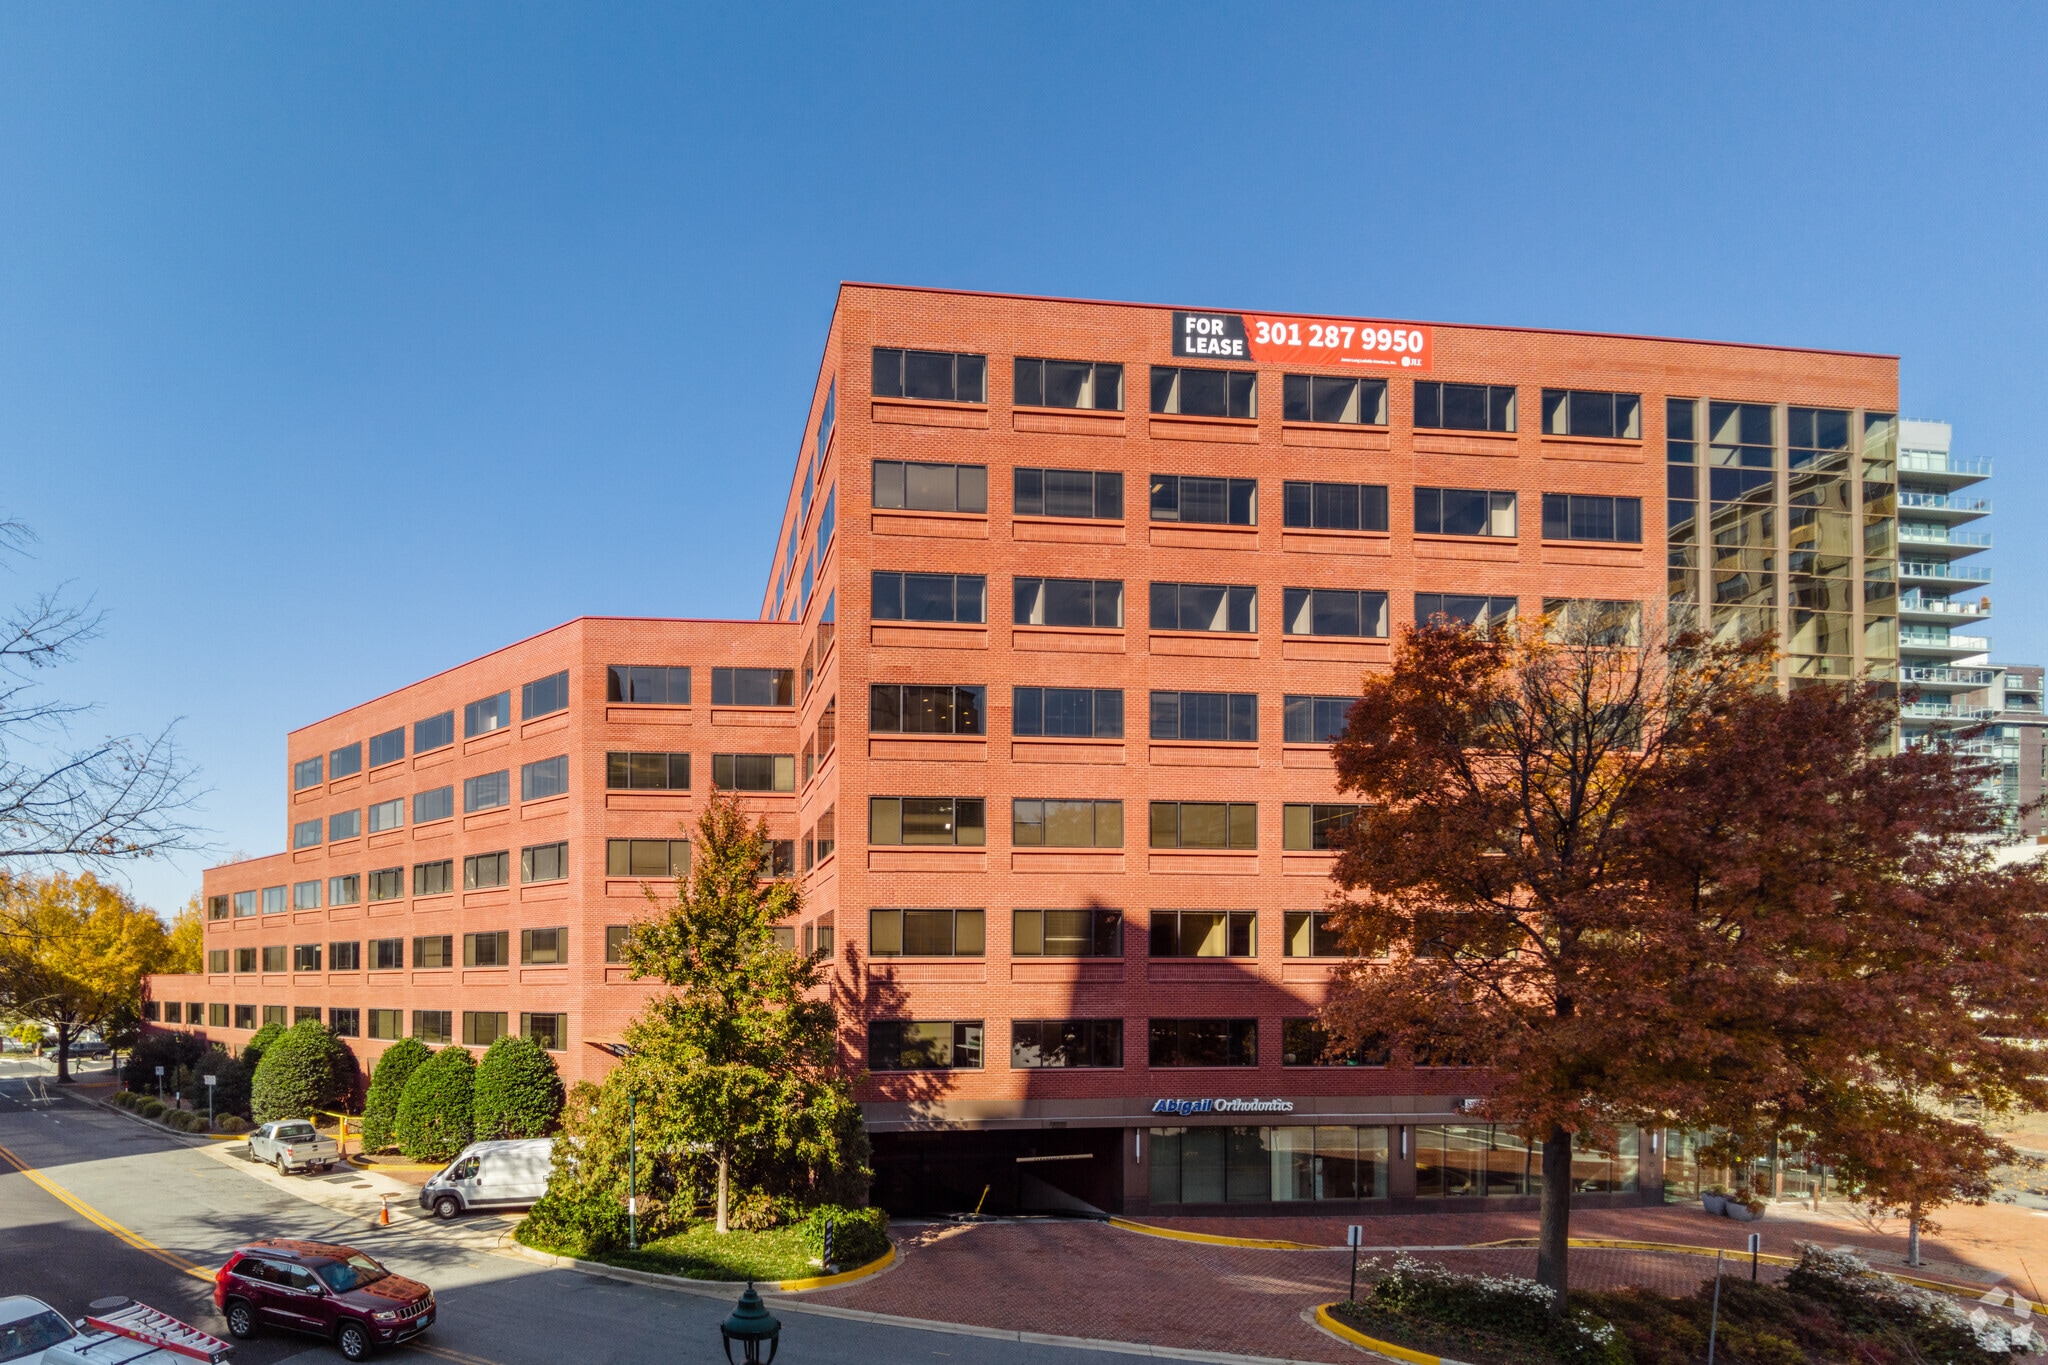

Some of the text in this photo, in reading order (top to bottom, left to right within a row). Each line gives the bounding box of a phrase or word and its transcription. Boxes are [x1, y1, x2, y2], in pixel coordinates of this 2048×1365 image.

[1186, 317, 1224, 335] FOR
[1255, 321, 1423, 353] 301 287 9950
[1186, 337, 1243, 356] LEASE
[1152, 1098, 1294, 1116] Abigail Orthodontics
